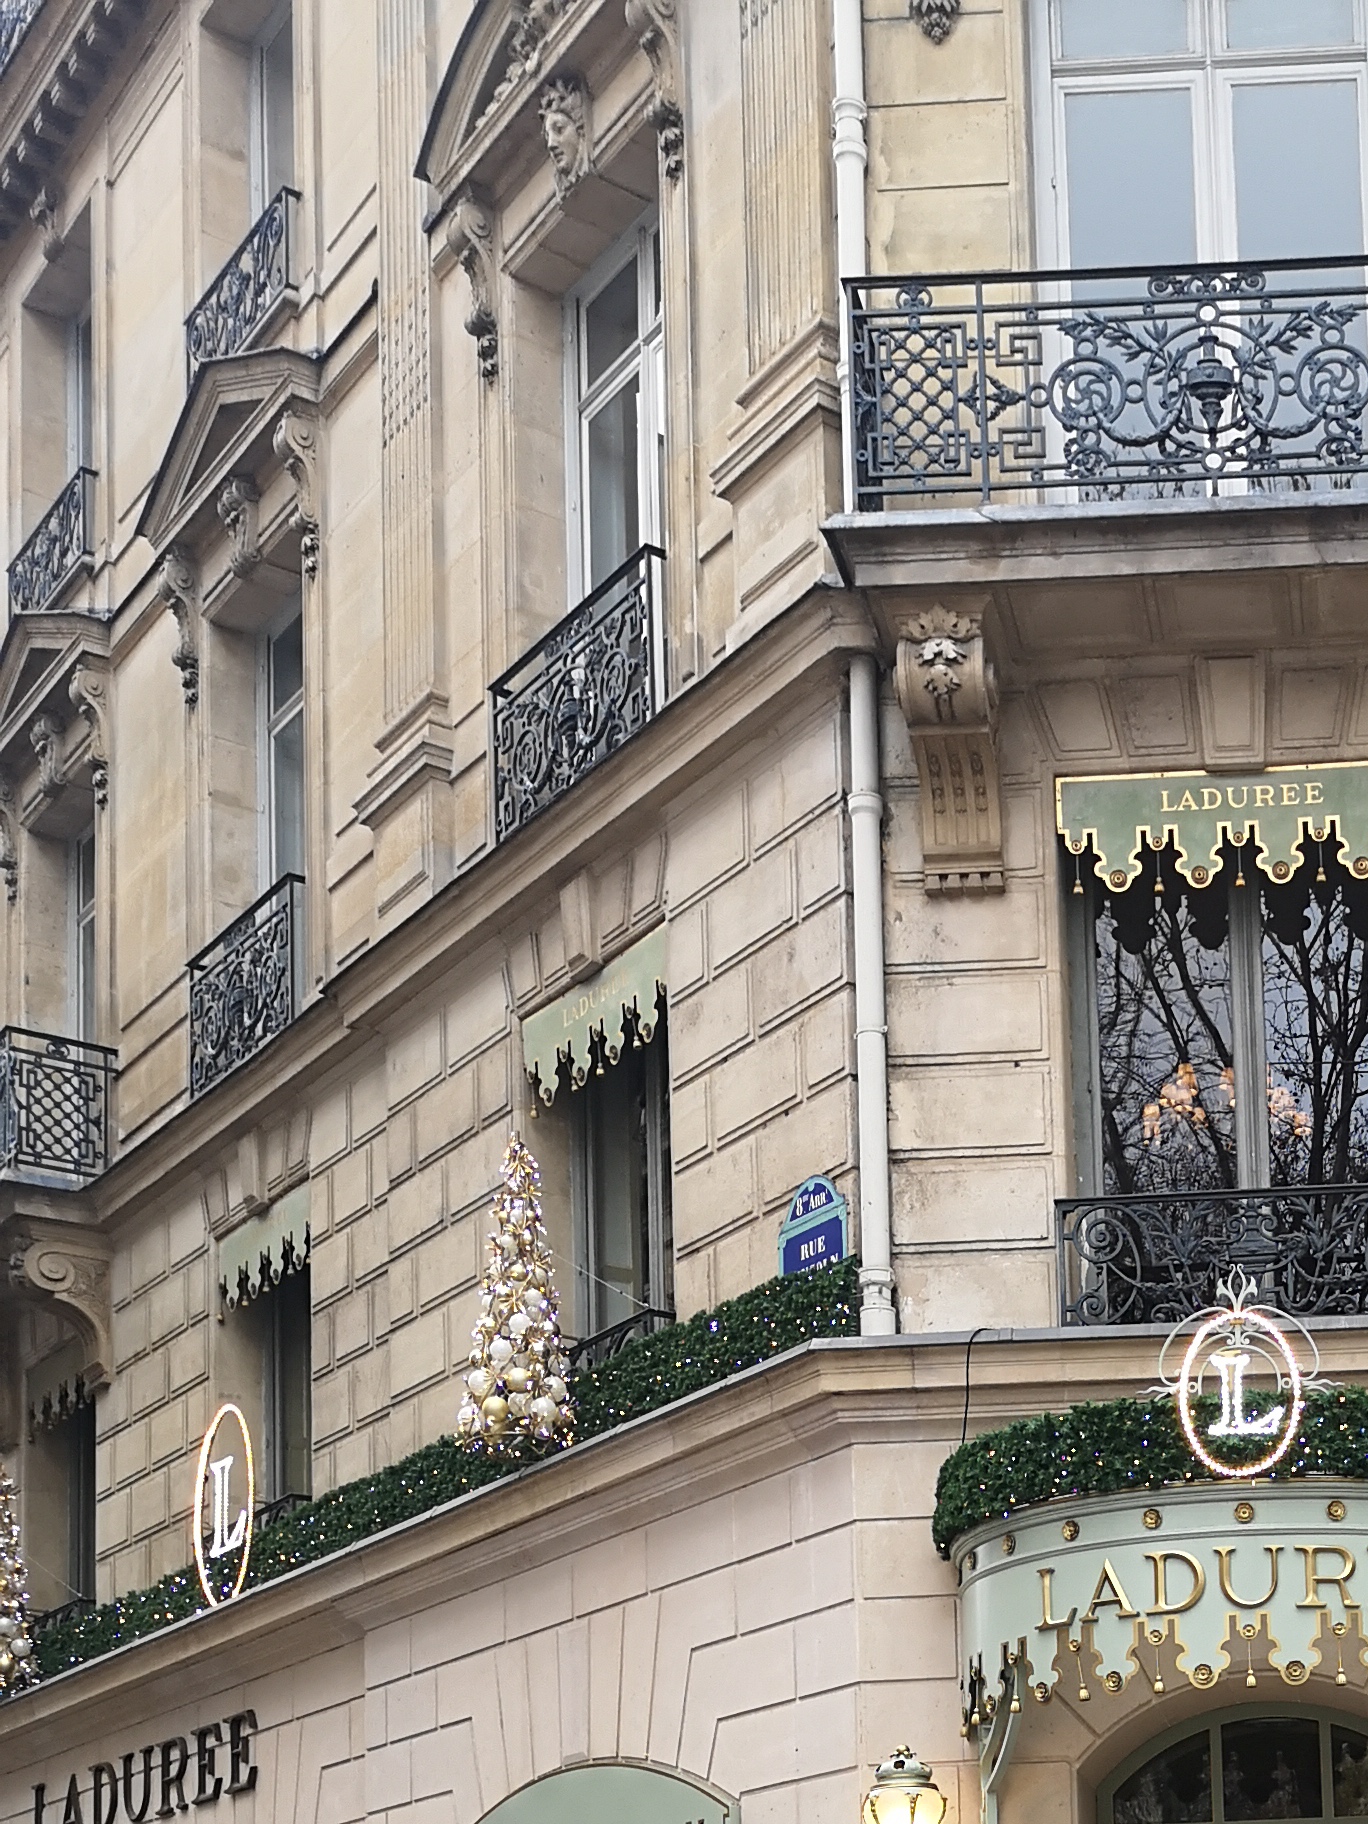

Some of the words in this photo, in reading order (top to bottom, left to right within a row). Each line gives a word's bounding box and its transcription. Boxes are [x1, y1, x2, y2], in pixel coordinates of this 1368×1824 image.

[1160, 782, 1325, 812] LADUREE
[800, 1235, 826, 1261] RUE
[1207, 1350, 1285, 1437] L
[208, 1455, 248, 1558] L
